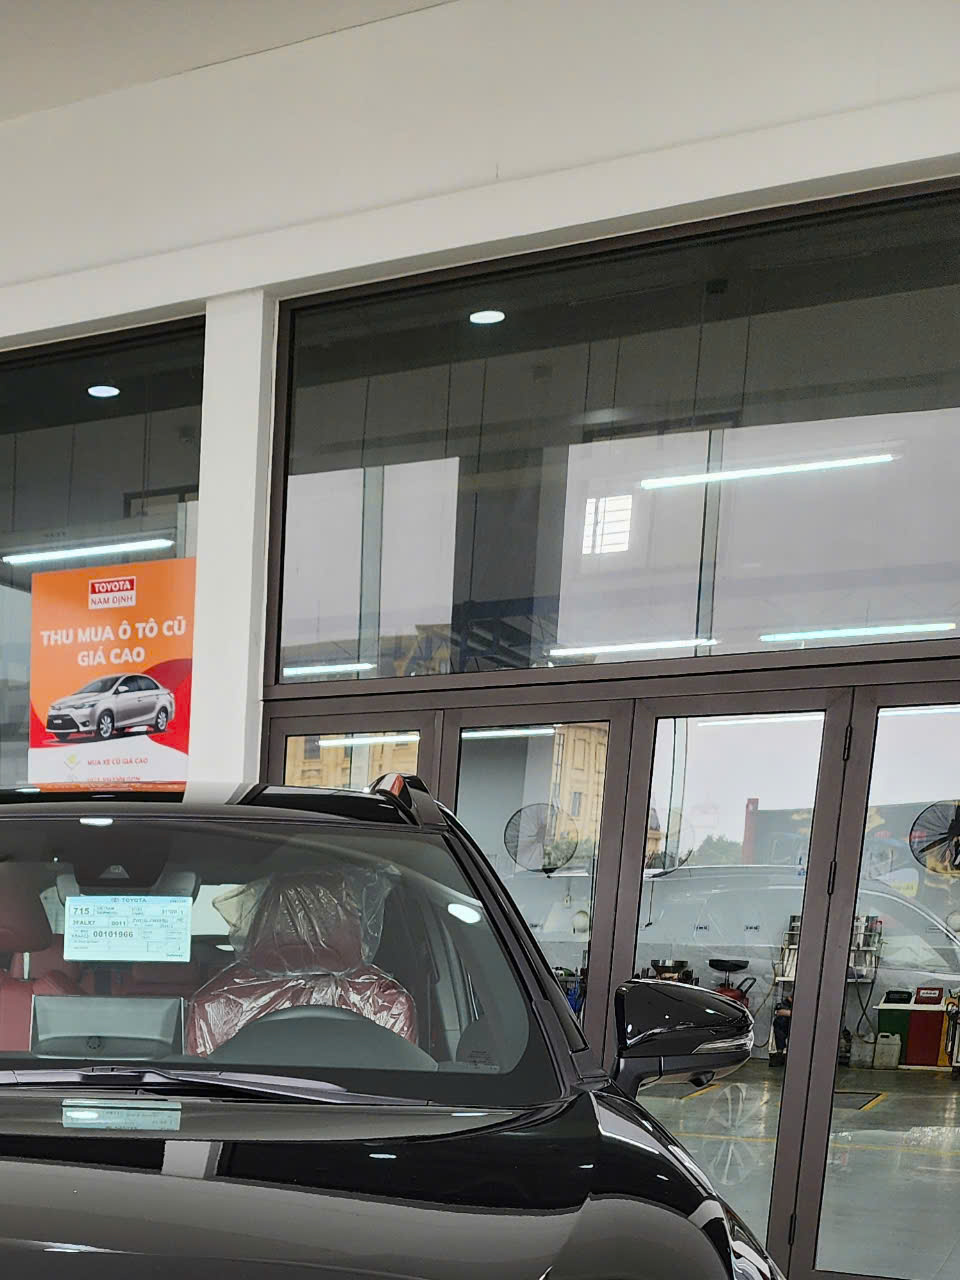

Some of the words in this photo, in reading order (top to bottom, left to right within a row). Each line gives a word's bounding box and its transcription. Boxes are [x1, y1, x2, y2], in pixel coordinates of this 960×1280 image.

[93, 581, 131, 593] TOYOTA
[91, 597, 110, 605] NAM
[40, 630, 74, 646] THU
[77, 626, 114, 644] MUA
[118, 620, 131, 640] Ô
[135, 618, 159, 638] TÔ
[162, 616, 186, 636] CŨ
[78, 647, 106, 666] GIÁ
[110, 647, 145, 664] CAO
[73, 907, 90, 915] 715
[93, 930, 134, 938] 00101966
